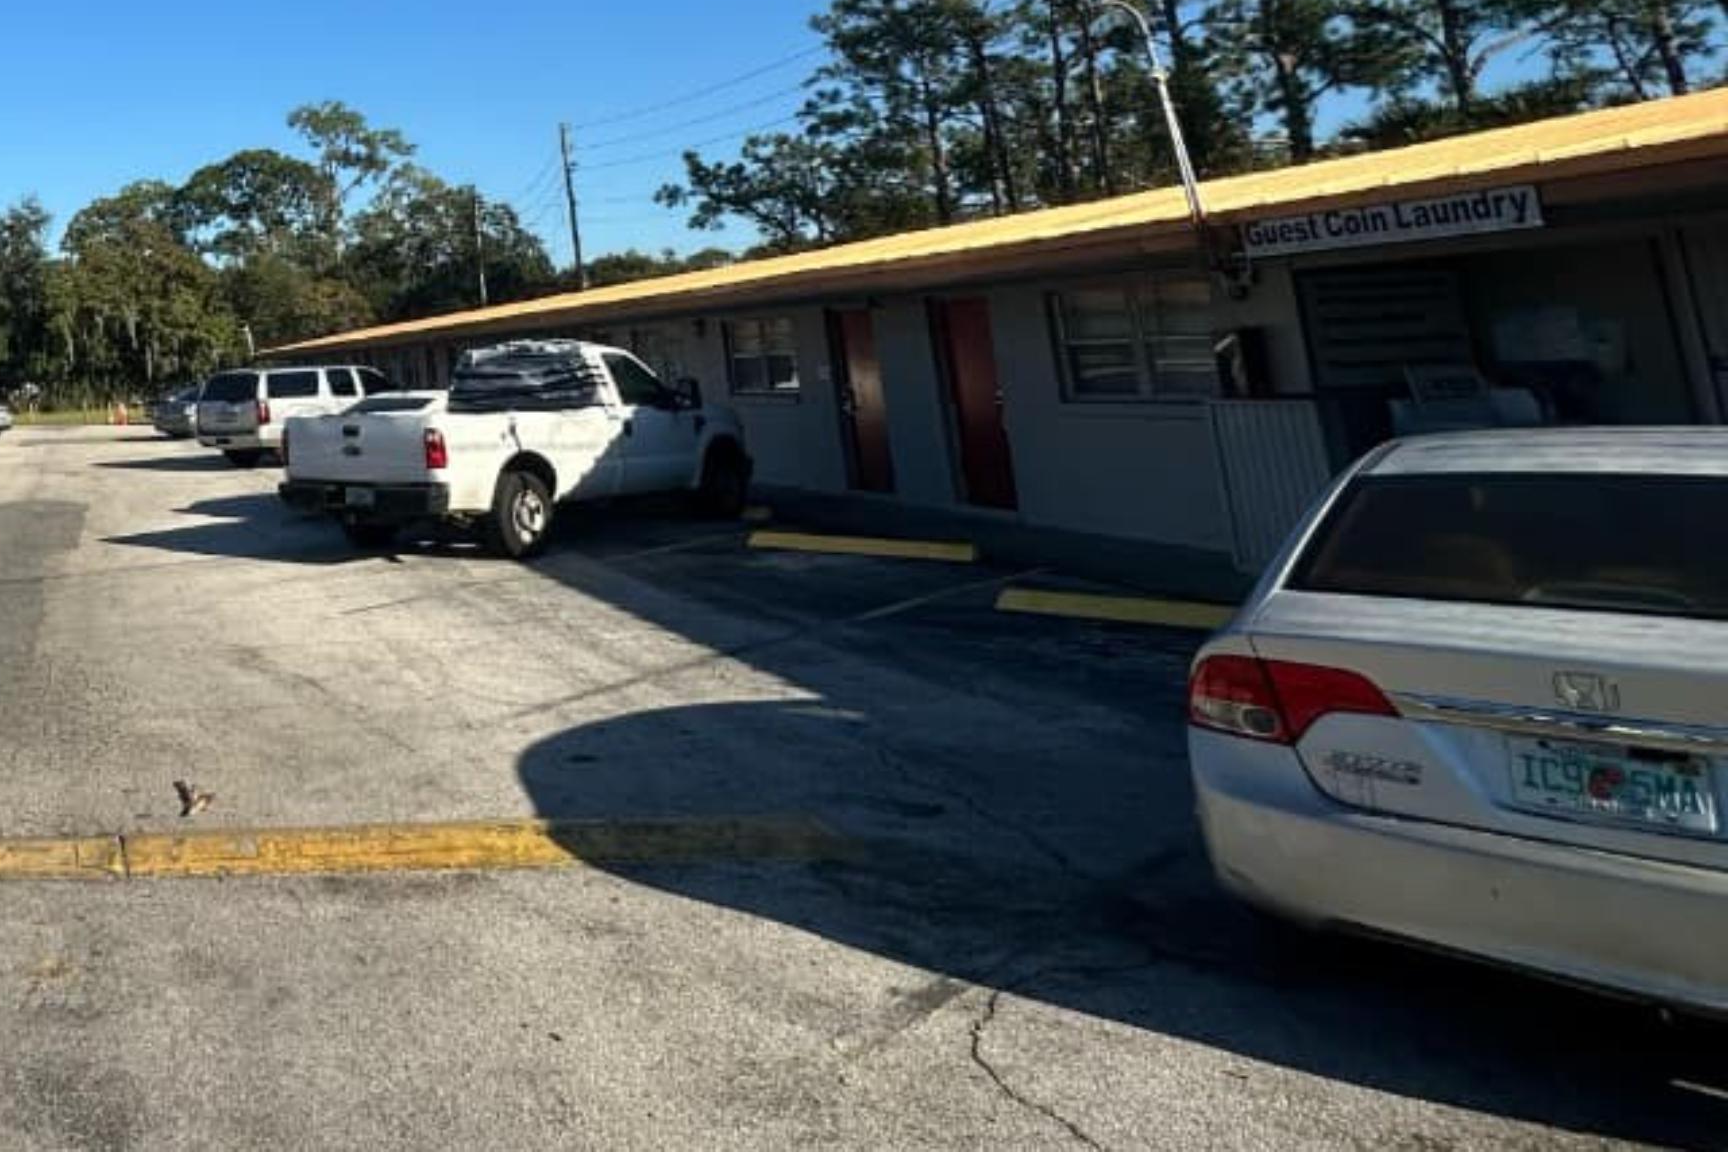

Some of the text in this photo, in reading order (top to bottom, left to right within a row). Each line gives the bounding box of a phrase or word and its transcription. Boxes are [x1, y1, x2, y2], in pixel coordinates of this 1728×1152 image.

[1246, 191, 1527, 247] Guest Coin Laundry
